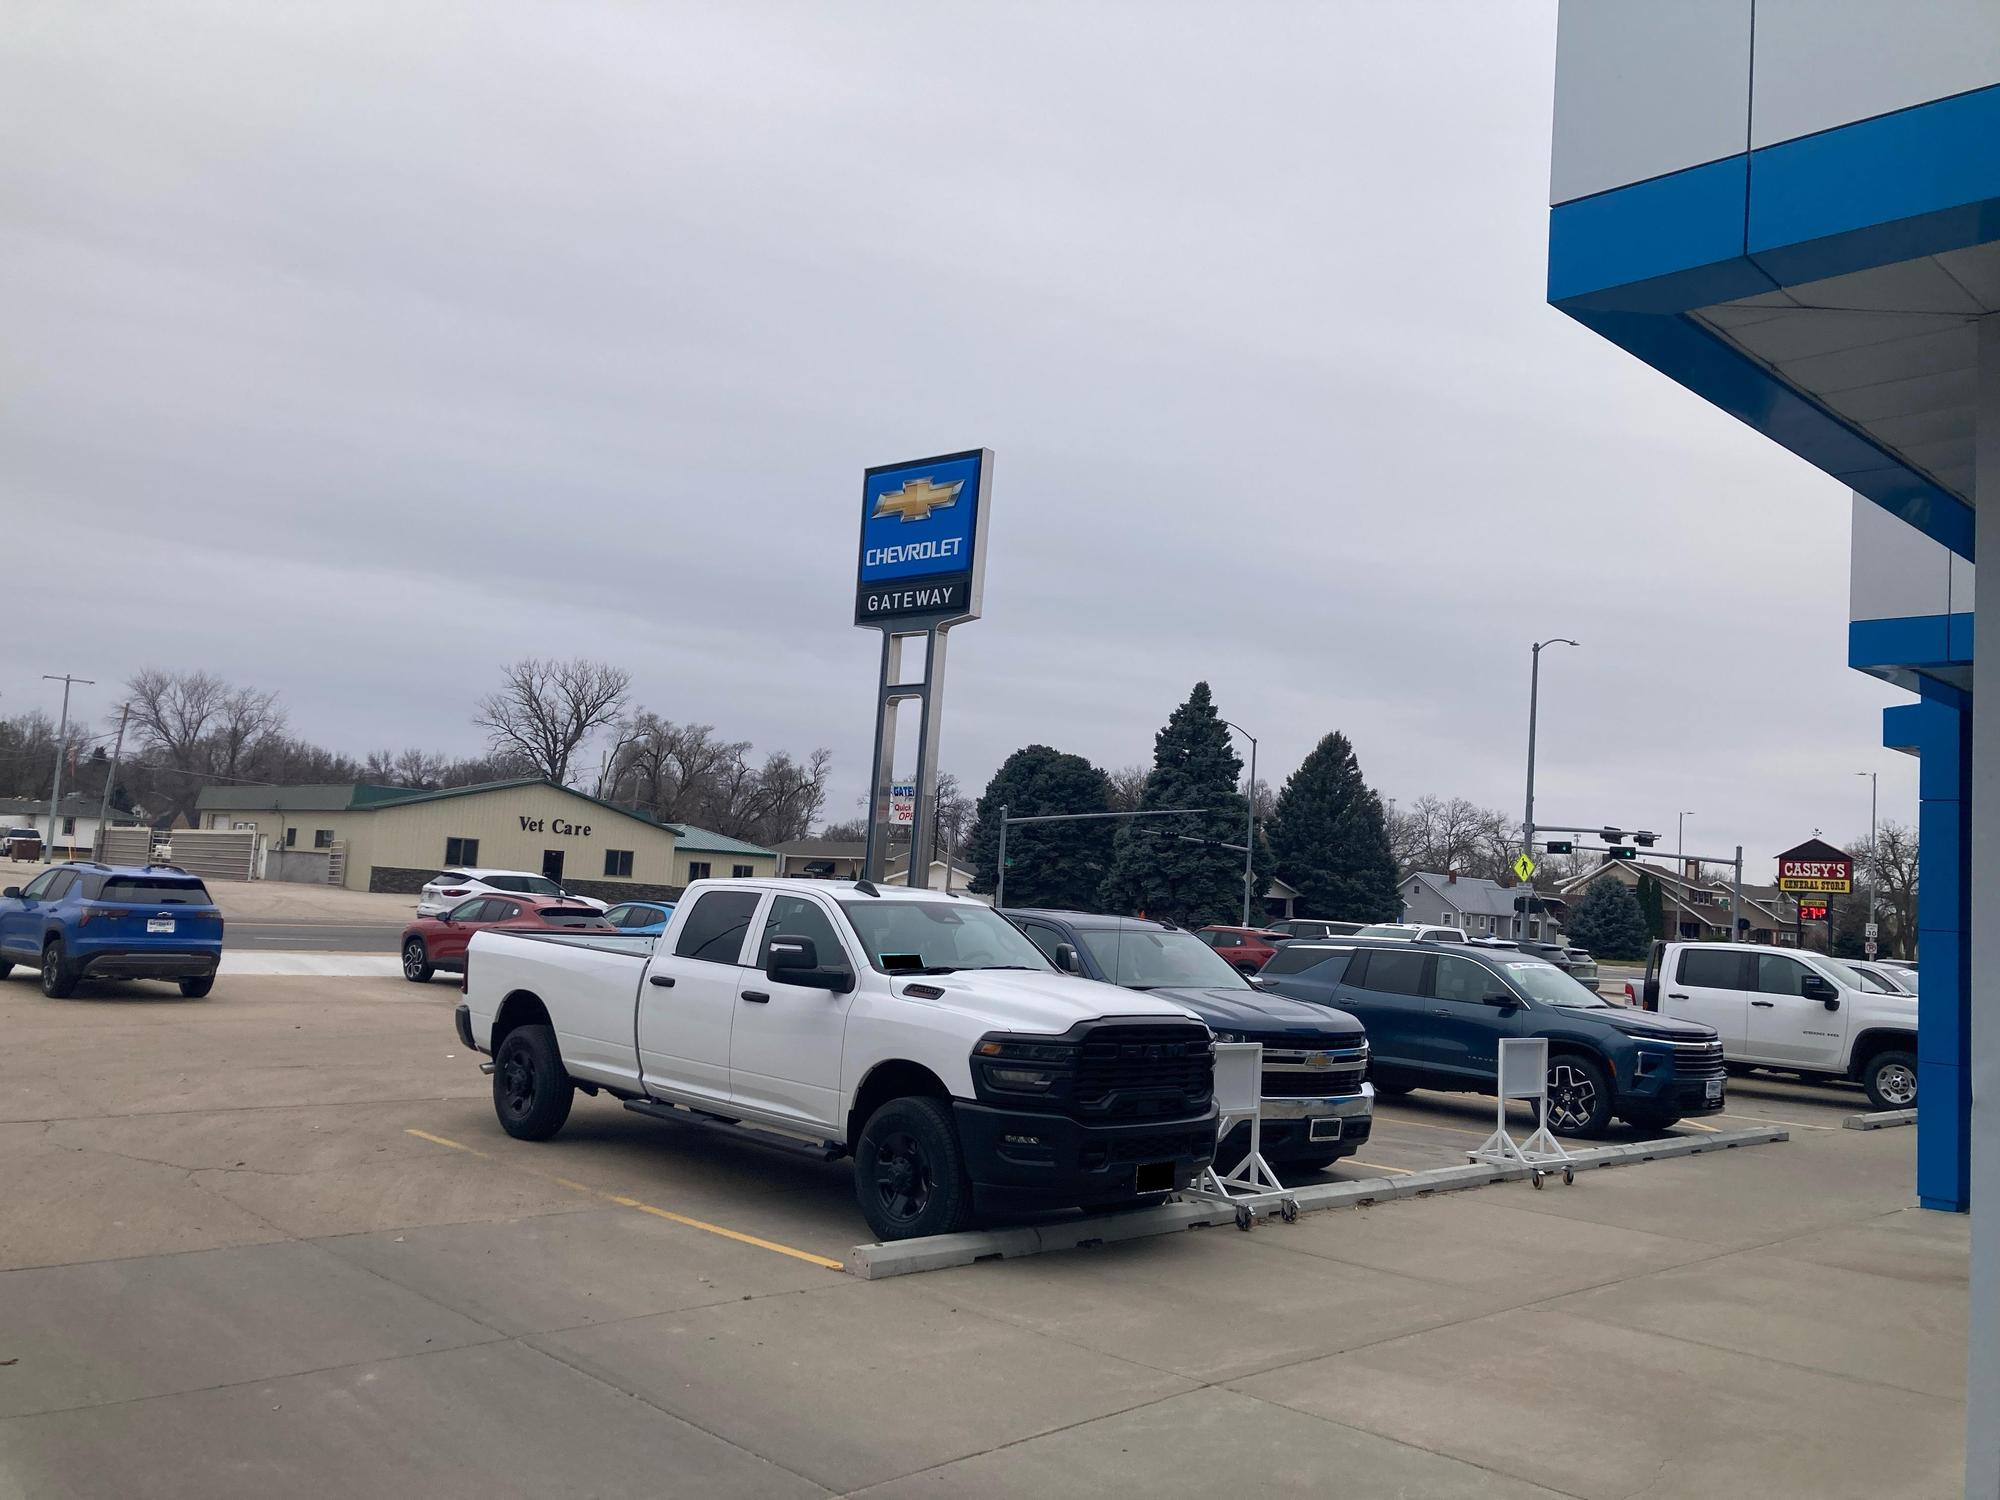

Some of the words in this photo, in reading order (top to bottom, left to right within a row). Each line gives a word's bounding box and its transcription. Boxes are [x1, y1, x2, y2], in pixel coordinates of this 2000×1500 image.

[866, 537, 962, 567] CHEVROLET
[867, 587, 953, 612] GATEWAY
[894, 803, 912, 811] Quick
[519, 816, 544, 833] Vet
[552, 818, 592, 837] Care
[1784, 862, 1846, 878] CASEY'S
[1784, 880, 1819, 890] GENERAL
[1821, 881, 1846, 891] STORE
